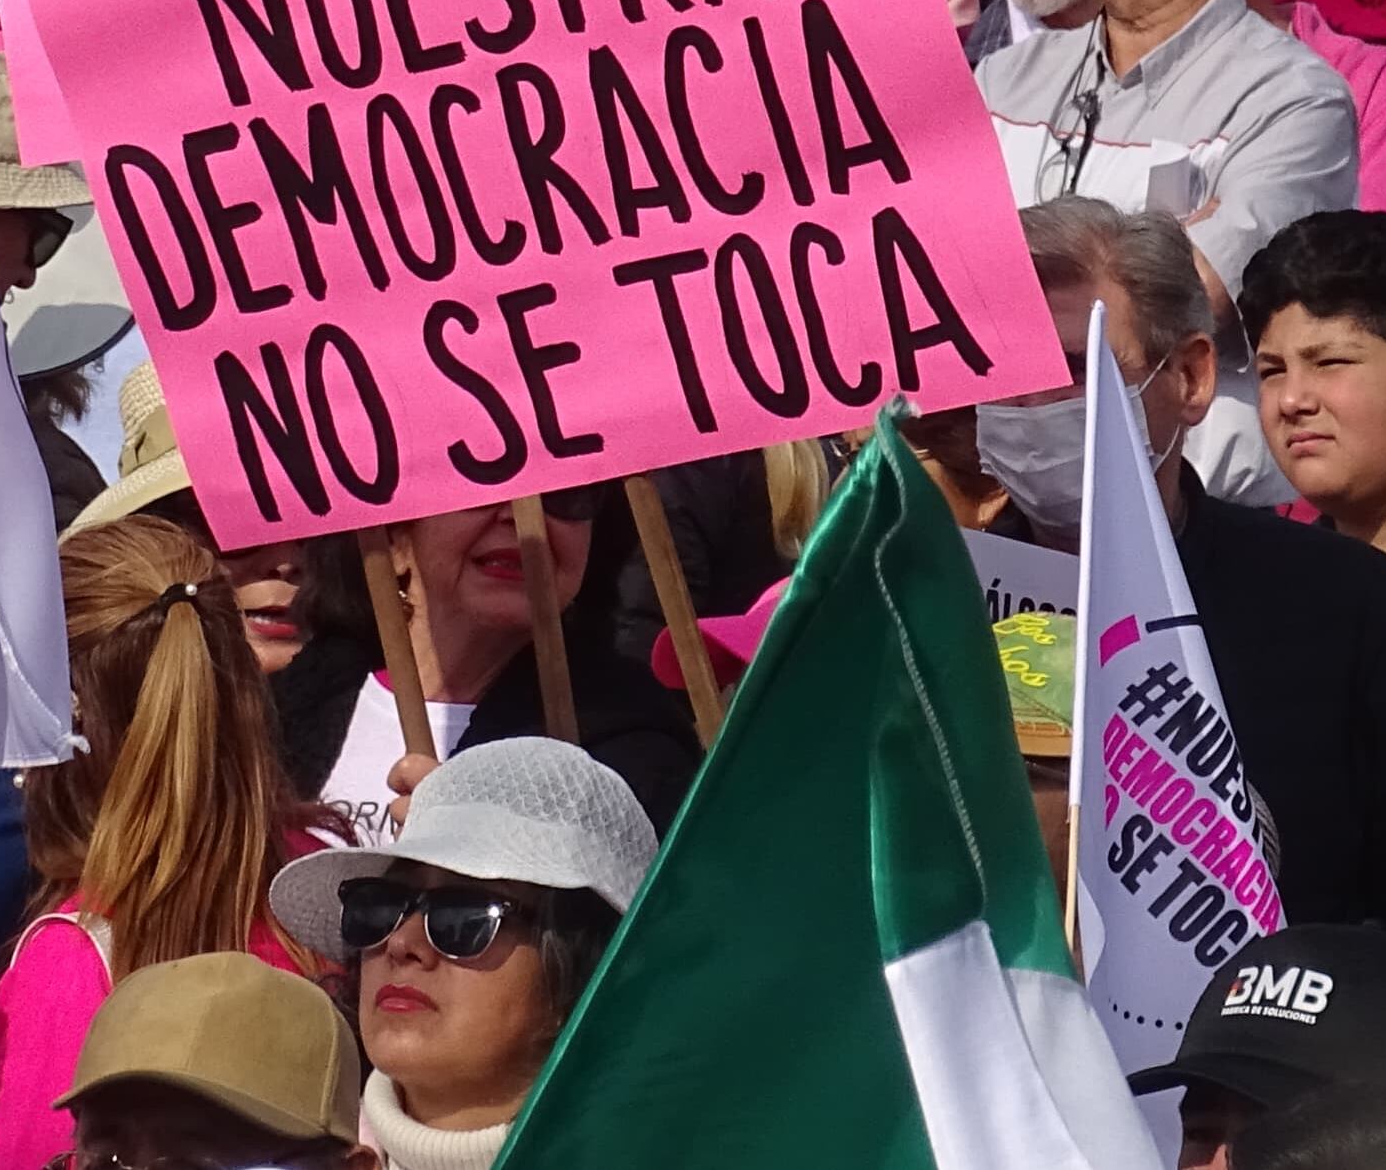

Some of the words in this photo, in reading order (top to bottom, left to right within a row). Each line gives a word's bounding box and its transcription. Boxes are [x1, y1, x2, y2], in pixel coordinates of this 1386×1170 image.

[215, 324, 399, 522] NO
[424, 284, 603, 484] SE
[613, 208, 992, 433] TOCA
[1107, 813, 1177, 896] SE
[1147, 857, 1250, 968] TOC
[1263, 1007, 1317, 1025] SOLUCIONES
